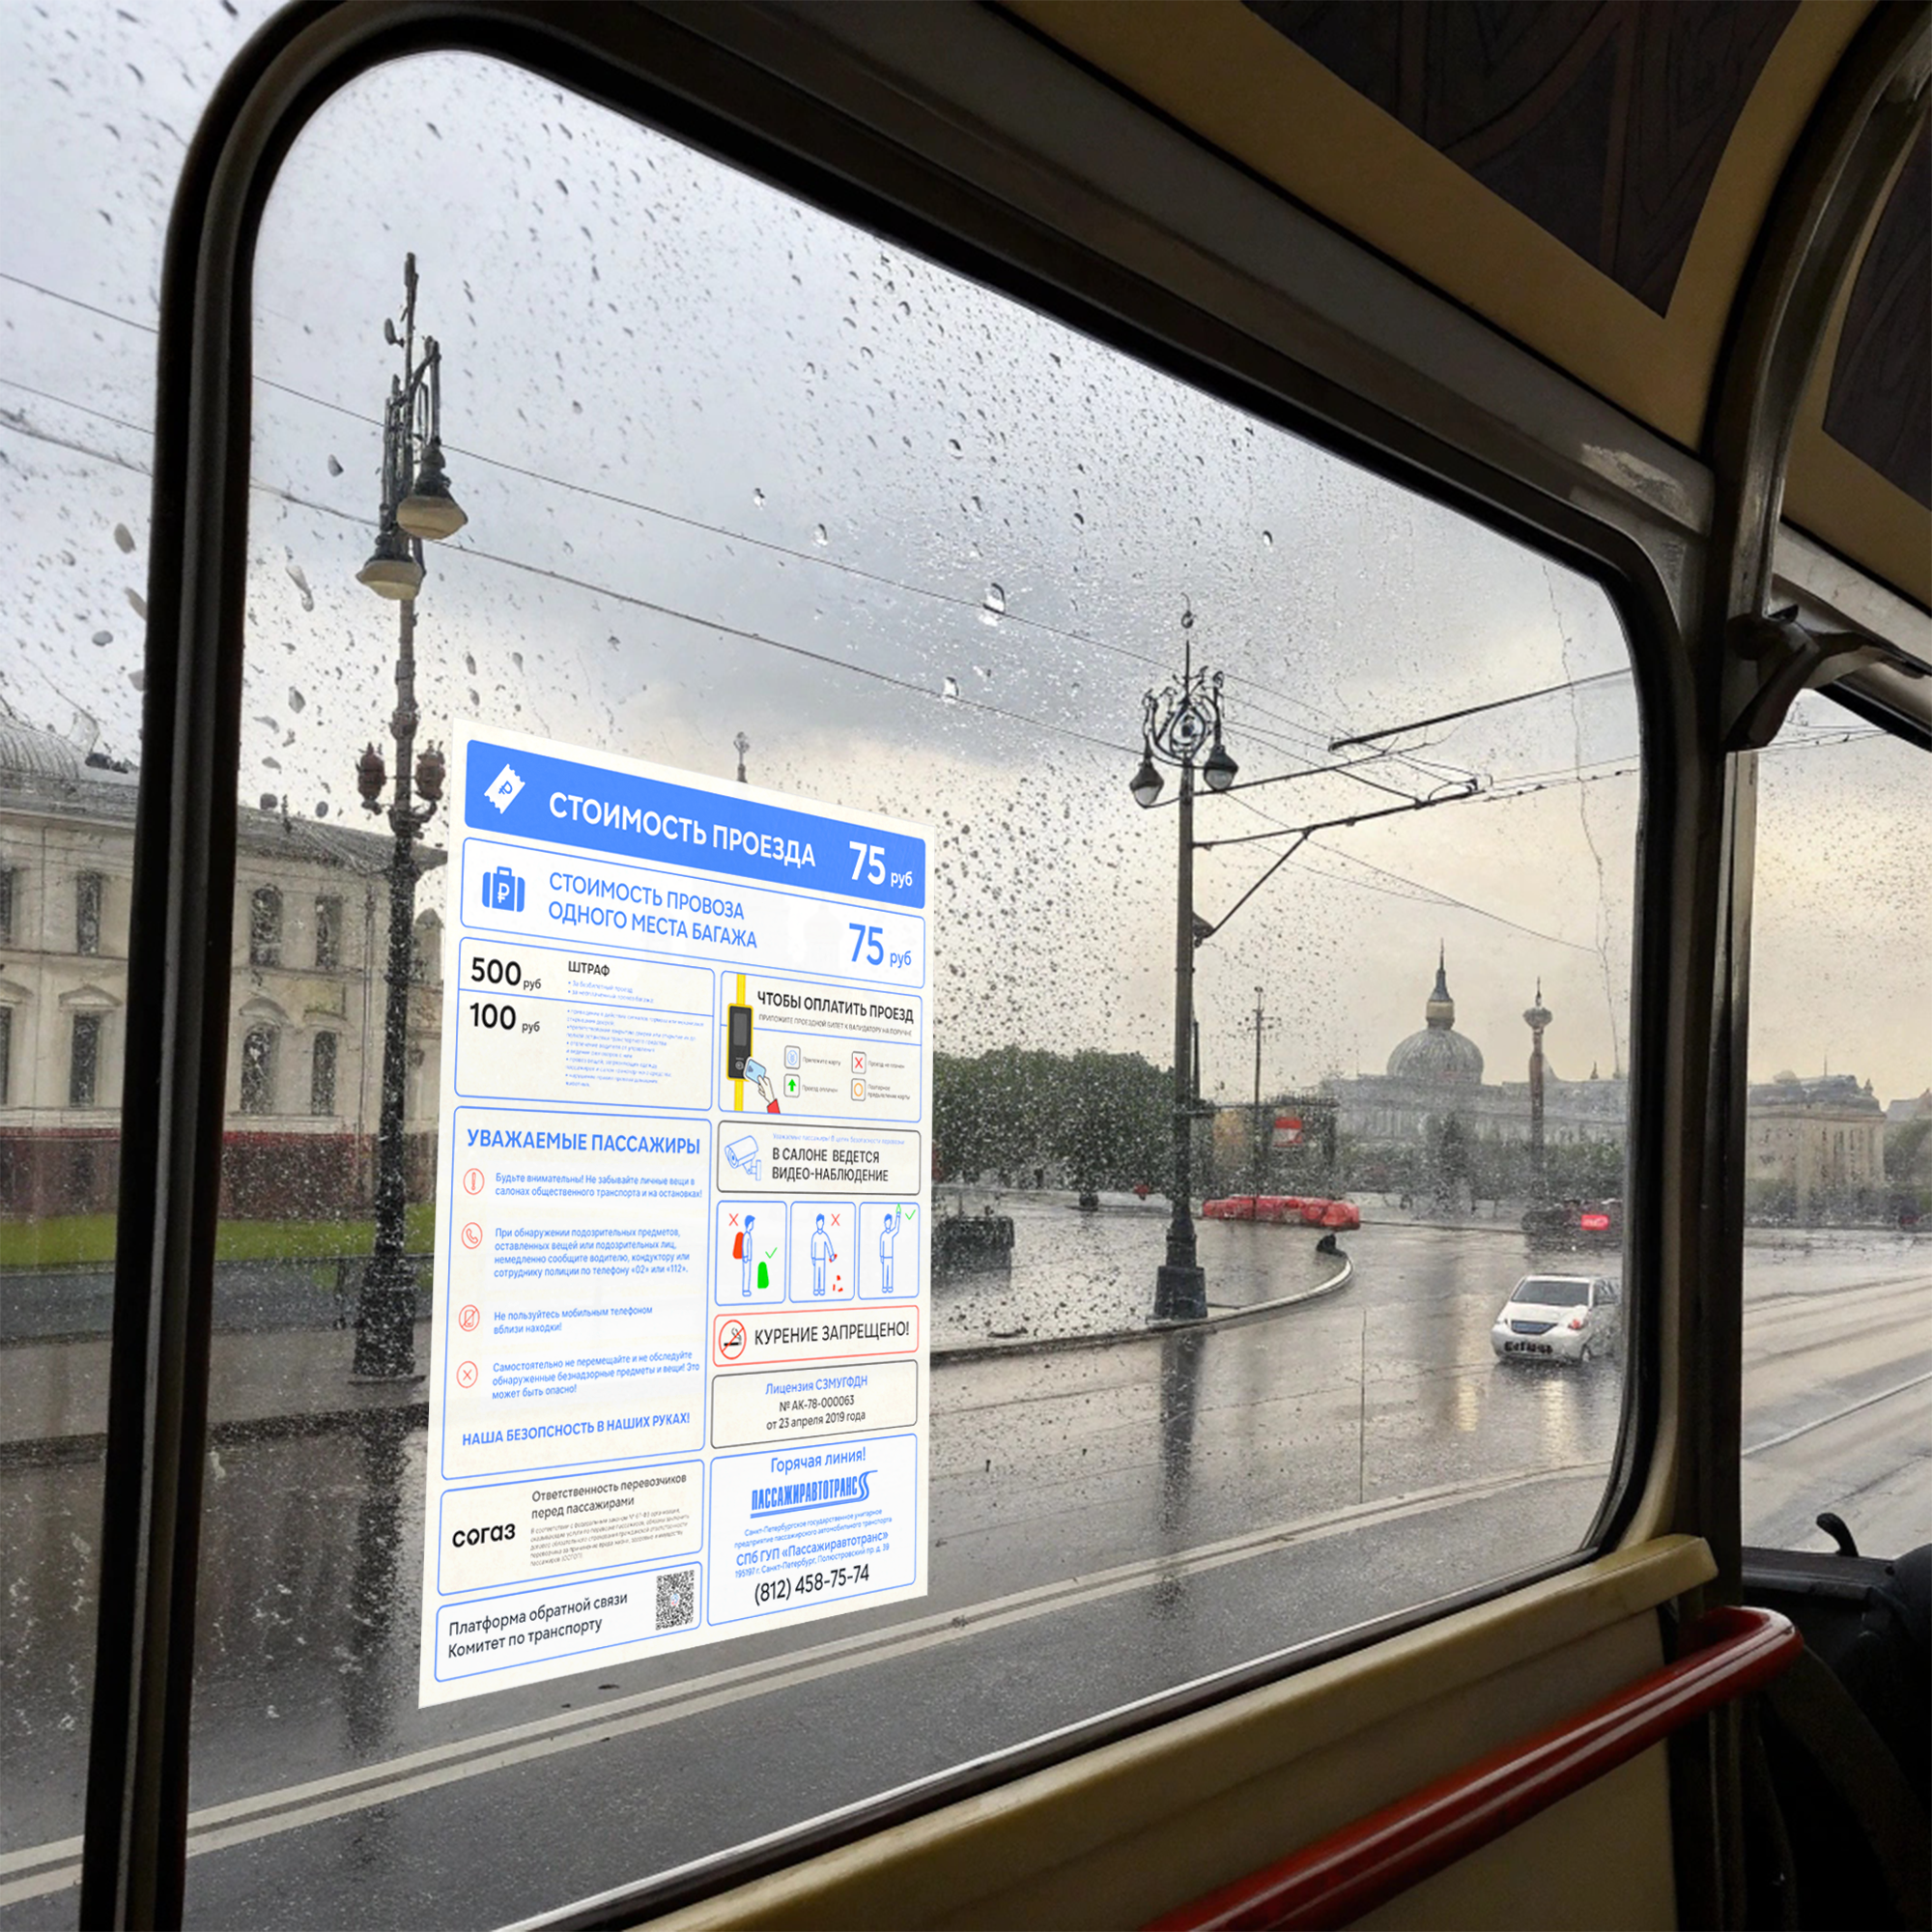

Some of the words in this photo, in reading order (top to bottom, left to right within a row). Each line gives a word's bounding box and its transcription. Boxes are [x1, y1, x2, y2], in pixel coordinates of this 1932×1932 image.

[549, 791, 706, 844] СТОИМОСТЬ
[713, 824, 815, 868] ПРОЕЗДА
[849, 840, 885, 885] 75
[891, 870, 912, 889] руб
[549, 871, 663, 906] СТОИМОСТЬ
[667, 891, 744, 920] ПРОВОЗА
[548, 900, 627, 928] ОДНОГО
[632, 913, 688, 938] МЕСТА
[692, 922, 756, 948] БАГАЖА
[848, 922, 884, 965] 75
[470, 956, 521, 985] 500
[568, 960, 610, 977] ШТРАФ
[890, 950, 911, 968] руб
[523, 978, 541, 991] руб
[469, 1002, 516, 1030] 100
[757, 990, 801, 1009] ЧТОБЫ
[803, 996, 867, 1016] ОПЛАТИТЬ
[869, 1004, 914, 1024] ПРОЕЗД
[521, 1020, 540, 1034] руб
[467, 1128, 586, 1151] УВАЖАЕМЫЕ
[591, 1134, 699, 1154] ПАССАЖИРЫ
[772, 1147, 780, 1160] В
[781, 1147, 827, 1161] САЛОНЕ
[832, 1149, 879, 1165] ВЕДЕТСЯ
[496, 1172, 526, 1184] Будьте
[526, 1175, 583, 1183] внимательны!
[584, 1175, 596, 1183] Не
[598, 1174, 639, 1184] забывайте
[639, 1177, 668, 1185] личные
[668, 1178, 689, 1186] вещи
[772, 1166, 888, 1183] ВИДЕО-НАБЛЮДЕНИЕ
[495, 1187, 529, 1196] салонах
[530, 1185, 595, 1197] общественного
[596, 1188, 640, 1198] транспорта
[658, 1189, 702, 1198] остановках!
[495, 1227, 512, 1239] При
[514, 1227, 570, 1239] обнаружении
[571, 1229, 636, 1238] подозрительных
[638, 1229, 680, 1237] предметов,
[495, 1242, 550, 1251] оставленных
[551, 1240, 578, 1251] вещей
[595, 1241, 659, 1250] подозрительных
[660, 1240, 676, 1250] лиц,
[494, 1255, 546, 1264] немедленно
[547, 1253, 588, 1264] сообщите
[589, 1254, 630, 1264] водителю,
[631, 1253, 674, 1263] кондуктору
[494, 1268, 543, 1279] сотруднику
[544, 1267, 579, 1277] полиции
[592, 1265, 629, 1276] телефону
[631, 1264, 649, 1274] «02»
[666, 1264, 688, 1272] «112».
[494, 1311, 506, 1321] Не
[507, 1310, 559, 1321] пользуйтесь
[561, 1307, 609, 1318] мобильным
[610, 1306, 652, 1316] телефоном
[494, 1323, 524, 1334] вблизи
[526, 1321, 561, 1333] находки!
[754, 1325, 817, 1345] КУРЕНИЕ
[821, 1321, 909, 1341] ЗАПРЕЩЕНО!
[493, 1360, 563, 1372] Самостоятельно
[576, 1354, 631, 1368] перемещайте
[648, 1350, 692, 1361] обследуйте
[492, 1374, 555, 1386] обнаруженные
[557, 1369, 614, 1380] безнадзорные
[616, 1366, 655, 1378] предметы
[663, 1363, 685, 1373] вещи!
[686, 1362, 699, 1372] Это
[765, 1381, 813, 1394] Лицензия
[815, 1375, 867, 1390] СЗМУГФДН
[492, 1389, 520, 1399] может
[522, 1386, 544, 1397] быть
[545, 1383, 577, 1395] опасно!
[779, 1400, 790, 1411] №
[791, 1394, 854, 1410] АК-78-000063
[462, 1430, 503, 1445] НАША
[506, 1422, 594, 1441] БЕЗОПСНОСТЬ
[597, 1420, 604, 1432] В
[606, 1415, 650, 1431] НАШИХ
[652, 1412, 690, 1426] РУКАХ!
[766, 1420, 777, 1430] от
[778, 1417, 789, 1429] 23
[790, 1415, 823, 1429] апреля
[825, 1410, 845, 1424] 2019
[846, 1411, 866, 1422] года
[771, 1455, 821, 1475] Горячая
[824, 1446, 866, 1465] линия!
[531, 1483, 618, 1502] Ответственность
[620, 1474, 686, 1492] перевозчиков
[751, 1475, 857, 1510] ПАССАЖИРАВТОТРАНС
[531, 1506, 564, 1520] перед
[566, 1496, 634, 1514] пассажирами
[744, 1520, 806, 1536] Санкт-Петербургское
[807, 1513, 853, 1526] государственное
[854, 1509, 882, 1520] унитарное
[452, 1522, 515, 1548] согаз
[736, 1549, 758, 1566] СПб
[759, 1548, 780, 1562] ГУП
[781, 1531, 888, 1557] «Пассажиравтотранс»
[754, 1577, 791, 1606] (812)
[794, 1563, 869, 1594] 458-75-74
[448, 1612, 526, 1636] Платформа
[528, 1597, 590, 1622] обратной
[593, 1593, 627, 1609] связи
[448, 1636, 505, 1658] Комитет
[508, 1634, 525, 1646] по
[527, 1618, 602, 1645] транспорту
